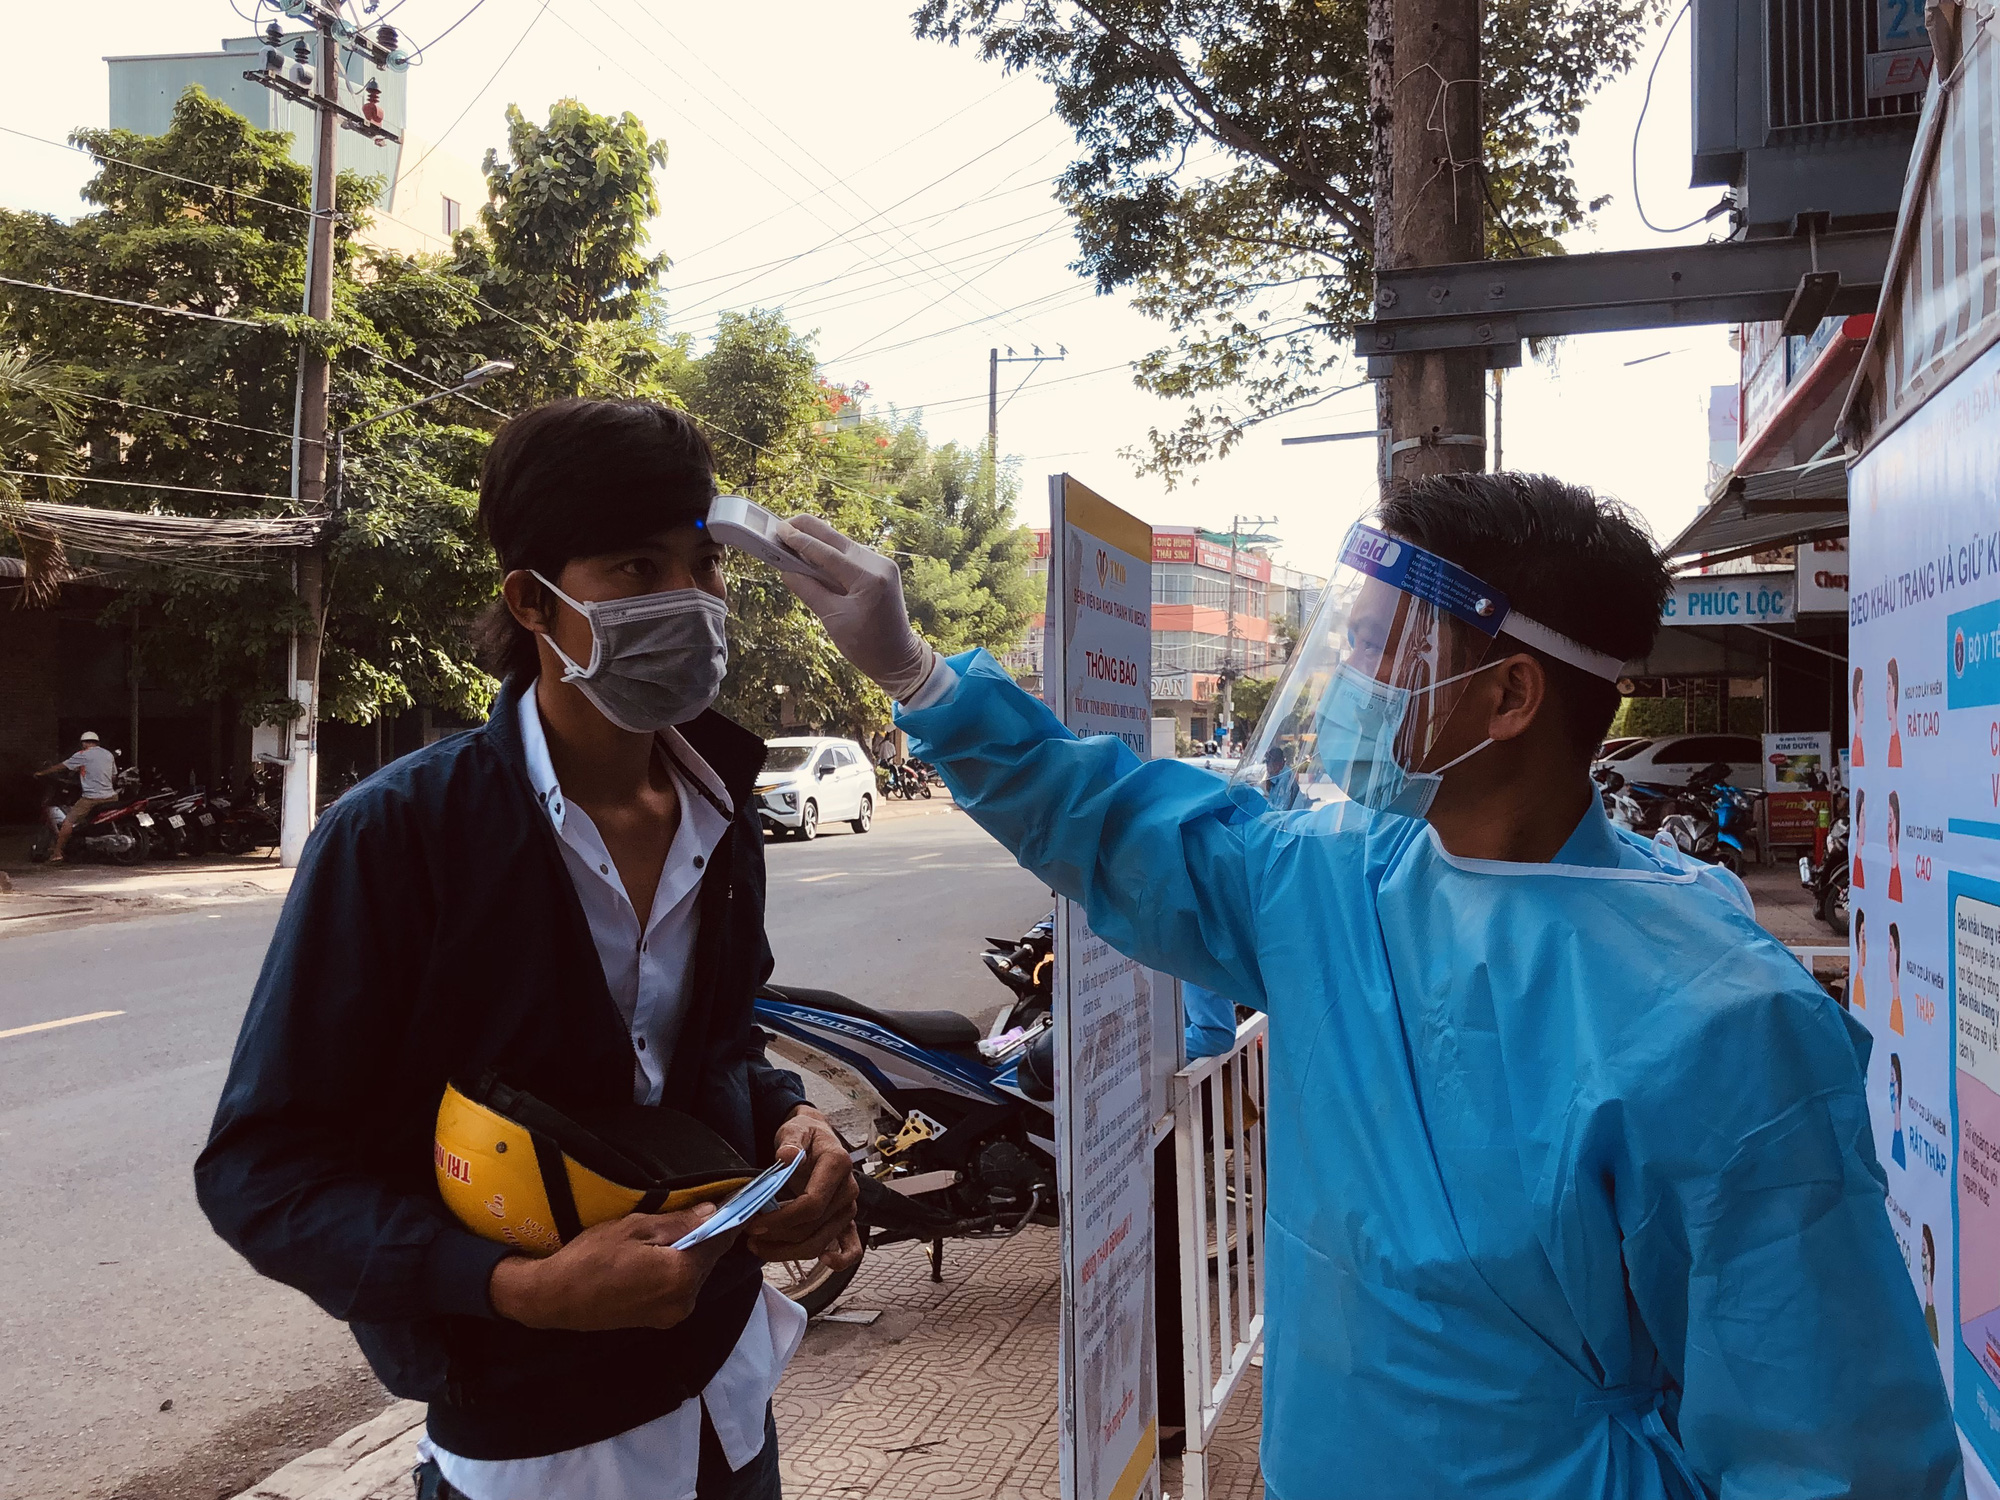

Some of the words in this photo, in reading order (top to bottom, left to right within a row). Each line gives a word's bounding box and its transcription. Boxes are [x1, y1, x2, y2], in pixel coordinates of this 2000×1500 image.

[1850, 592, 1869, 627] ĐEO
[1898, 561, 1935, 609] TRANG
[1937, 544, 1955, 594] VÀ
[1958, 532, 1984, 586] GIỮ
[1688, 585, 1739, 616] PHÚC
[1745, 584, 1784, 619] LỘC
[1085, 648, 1117, 682] THÔNG
[1119, 655, 1138, 686] BÁO
[1968, 631, 1981, 669] BỘ
[1982, 632, 1989, 661] Y
[1923, 710, 1940, 737] CAO
[1792, 741, 1819, 750] DUYÊN
[1915, 854, 1932, 881] CAO
[1958, 912, 1967, 931] Đeo
[1967, 913, 1979, 936] khẩu
[1981, 921, 1994, 946] trang
[1915, 993, 1935, 1025] THẤP
[1958, 987, 1968, 1008] Đeo
[1968, 991, 1980, 1014] khẩu
[1981, 1000, 1995, 1026] trang
[791, 1010, 871, 1038] EXCITER
[447, 1153, 471, 1184] TRÍ
[1909, 1125, 1923, 1159] RẤT
[1924, 1139, 1947, 1178] THẤP
